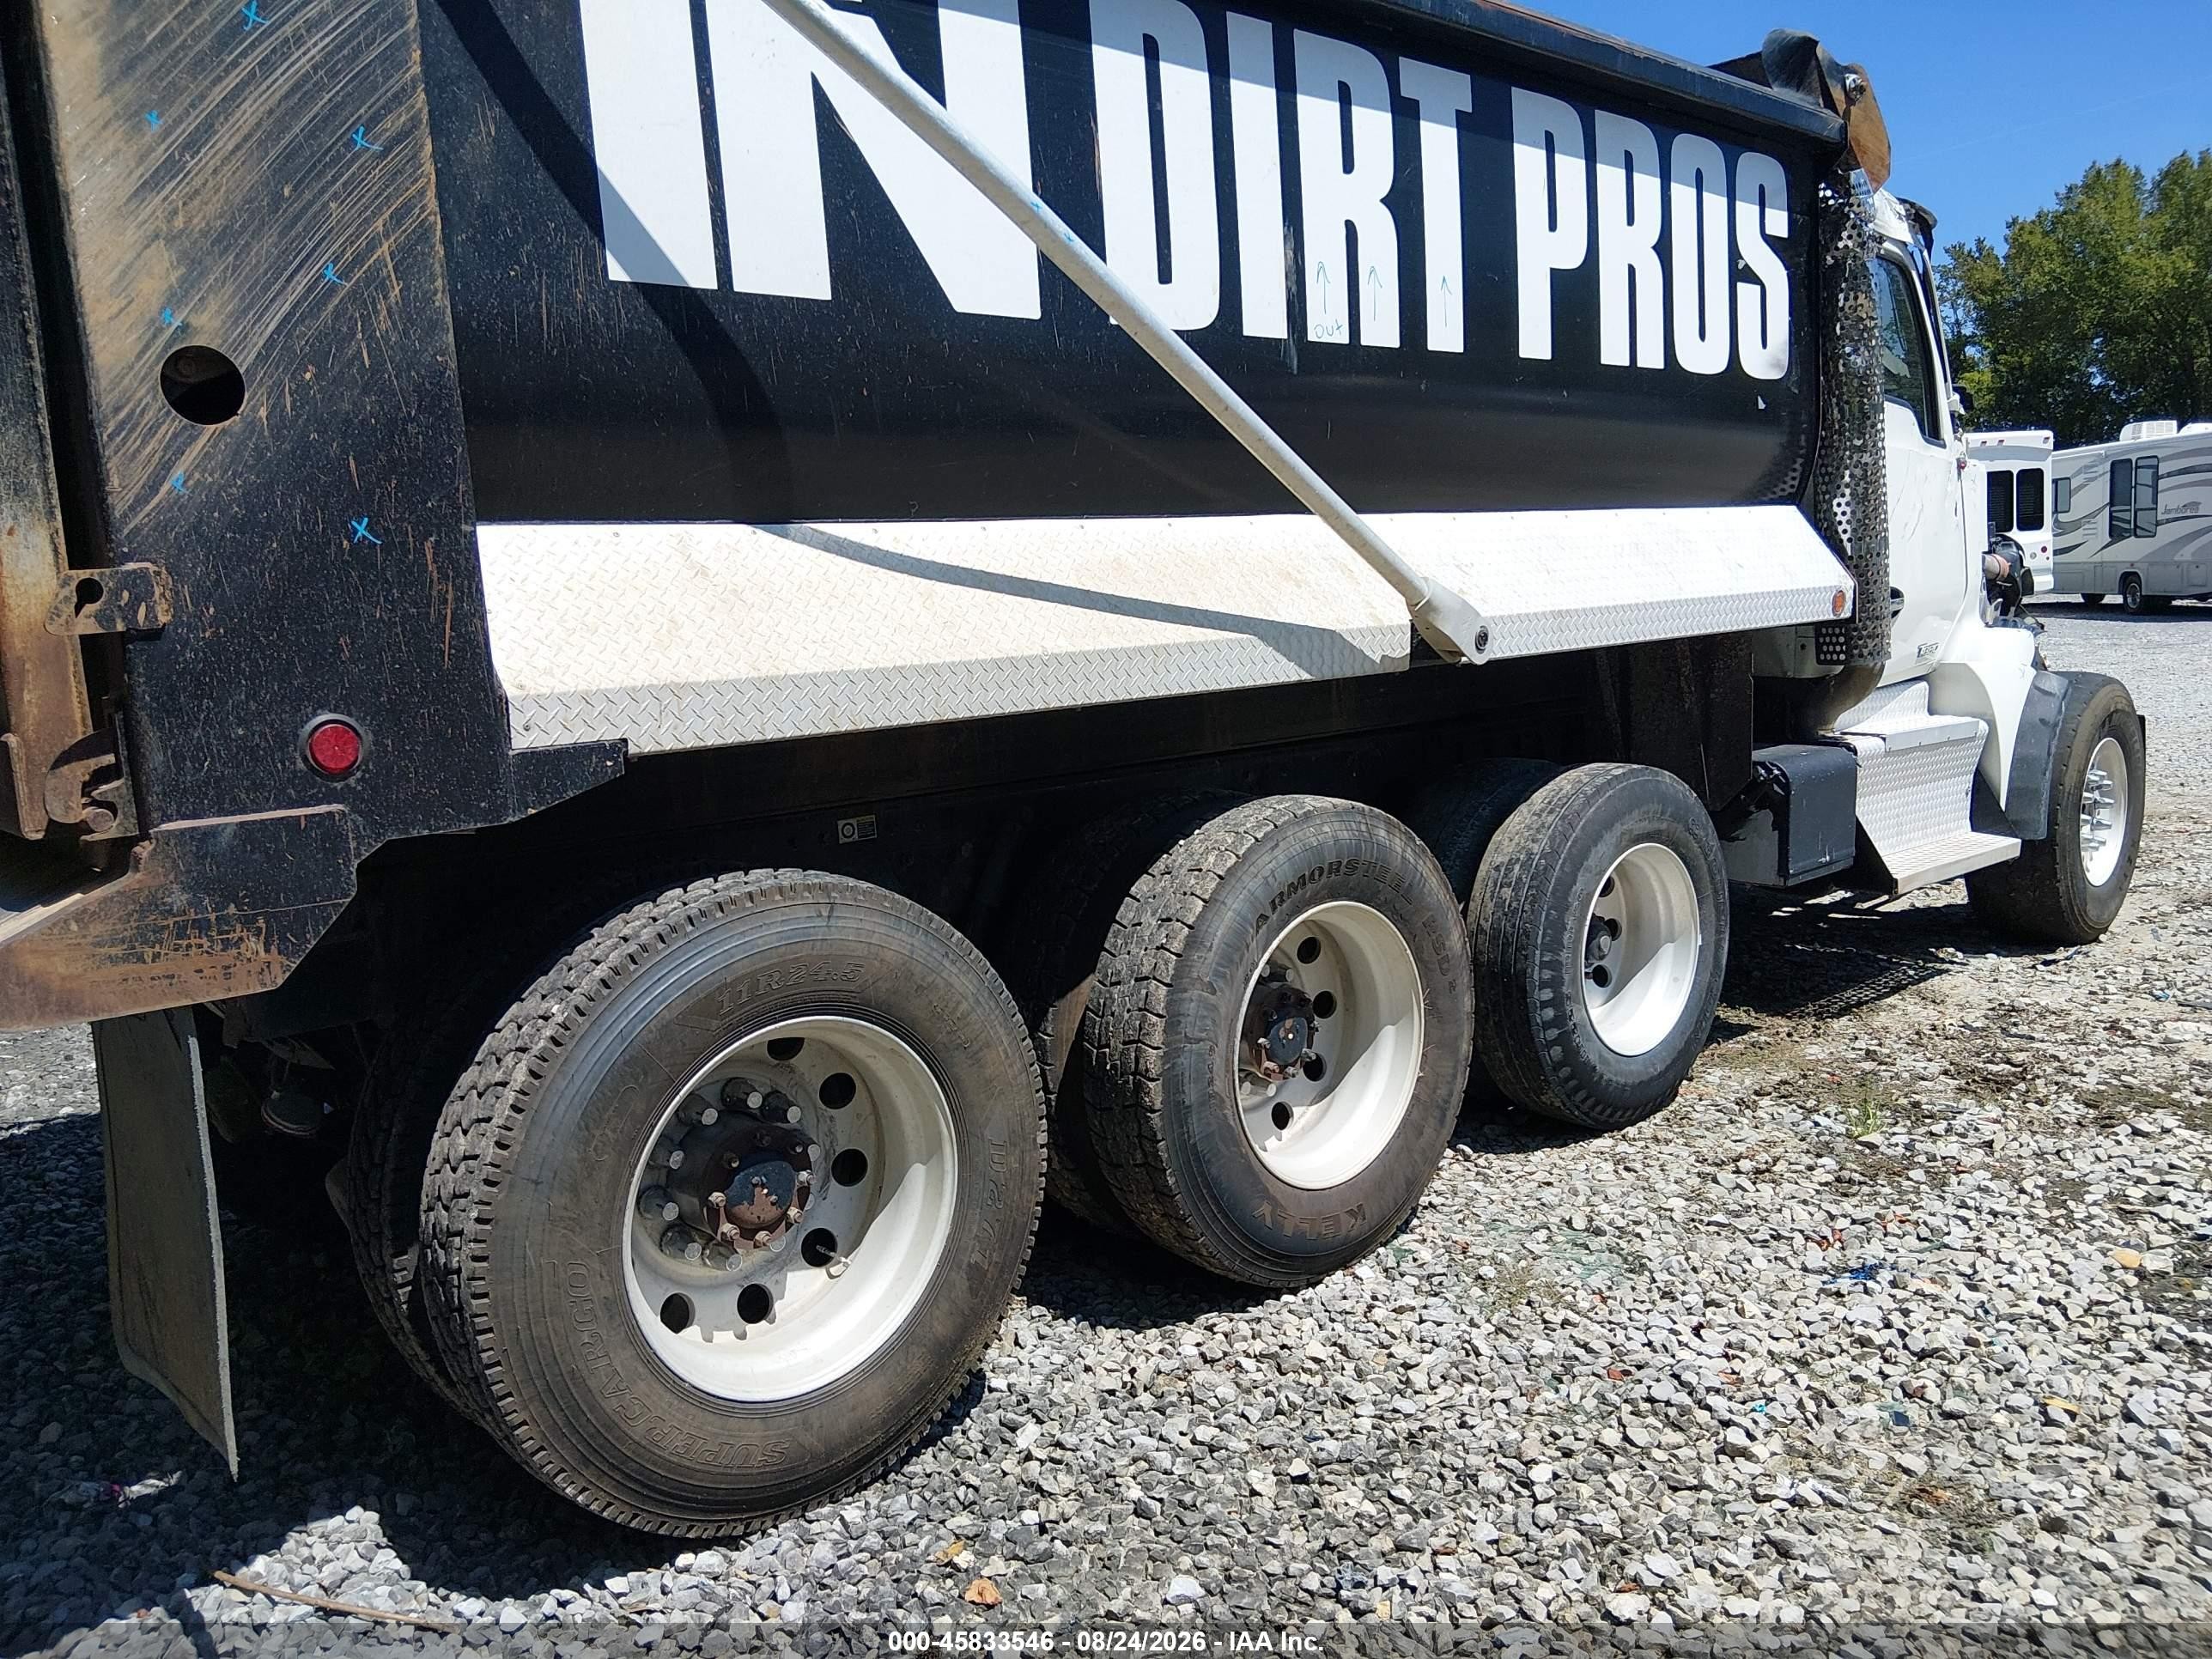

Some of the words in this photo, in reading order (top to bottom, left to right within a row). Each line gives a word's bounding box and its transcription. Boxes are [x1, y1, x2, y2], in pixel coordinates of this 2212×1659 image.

[1088, 0, 1473, 353] DIRT
[1511, 87, 1790, 380] PROS
[1254, 857, 1414, 937] ARMORSTEEL
[714, 960, 867, 1016] 11R24.5
[1250, 1199, 1368, 1242] KELLY
